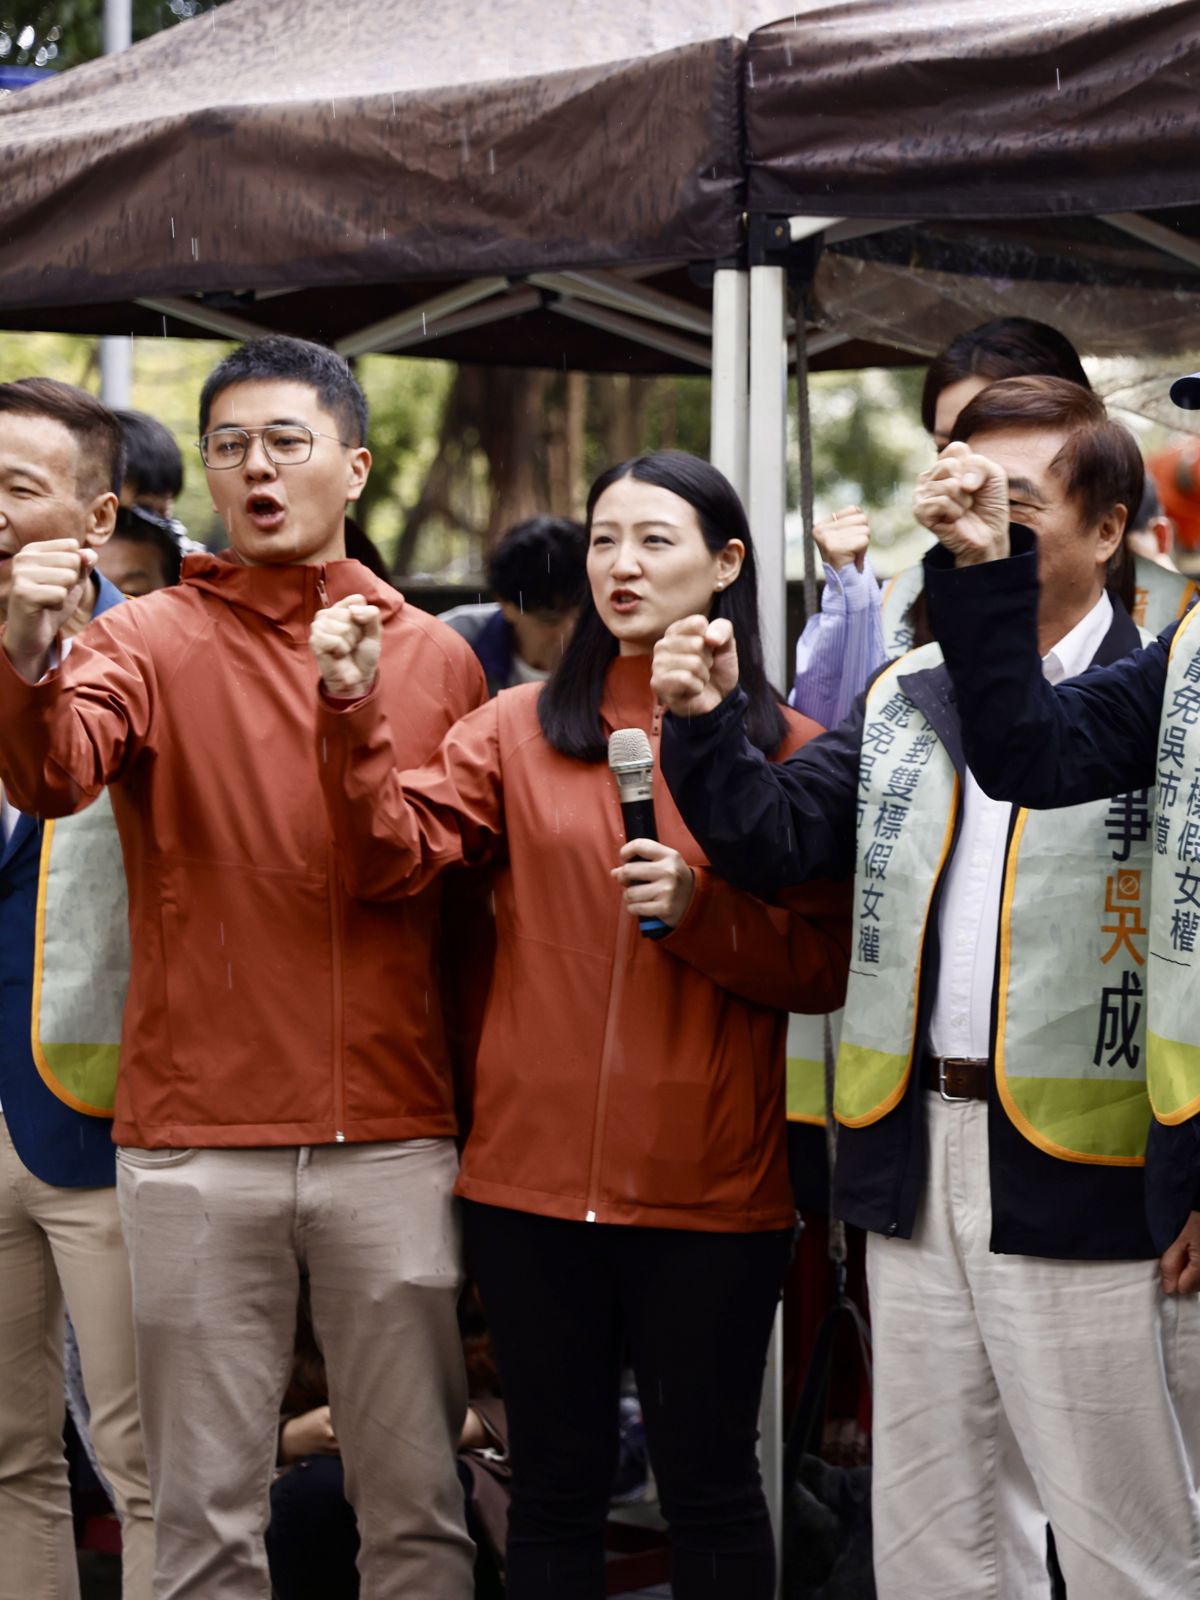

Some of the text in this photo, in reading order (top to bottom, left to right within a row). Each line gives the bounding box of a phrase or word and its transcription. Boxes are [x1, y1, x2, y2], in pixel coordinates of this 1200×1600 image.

[858, 718, 937, 963] 對雙標假女權
